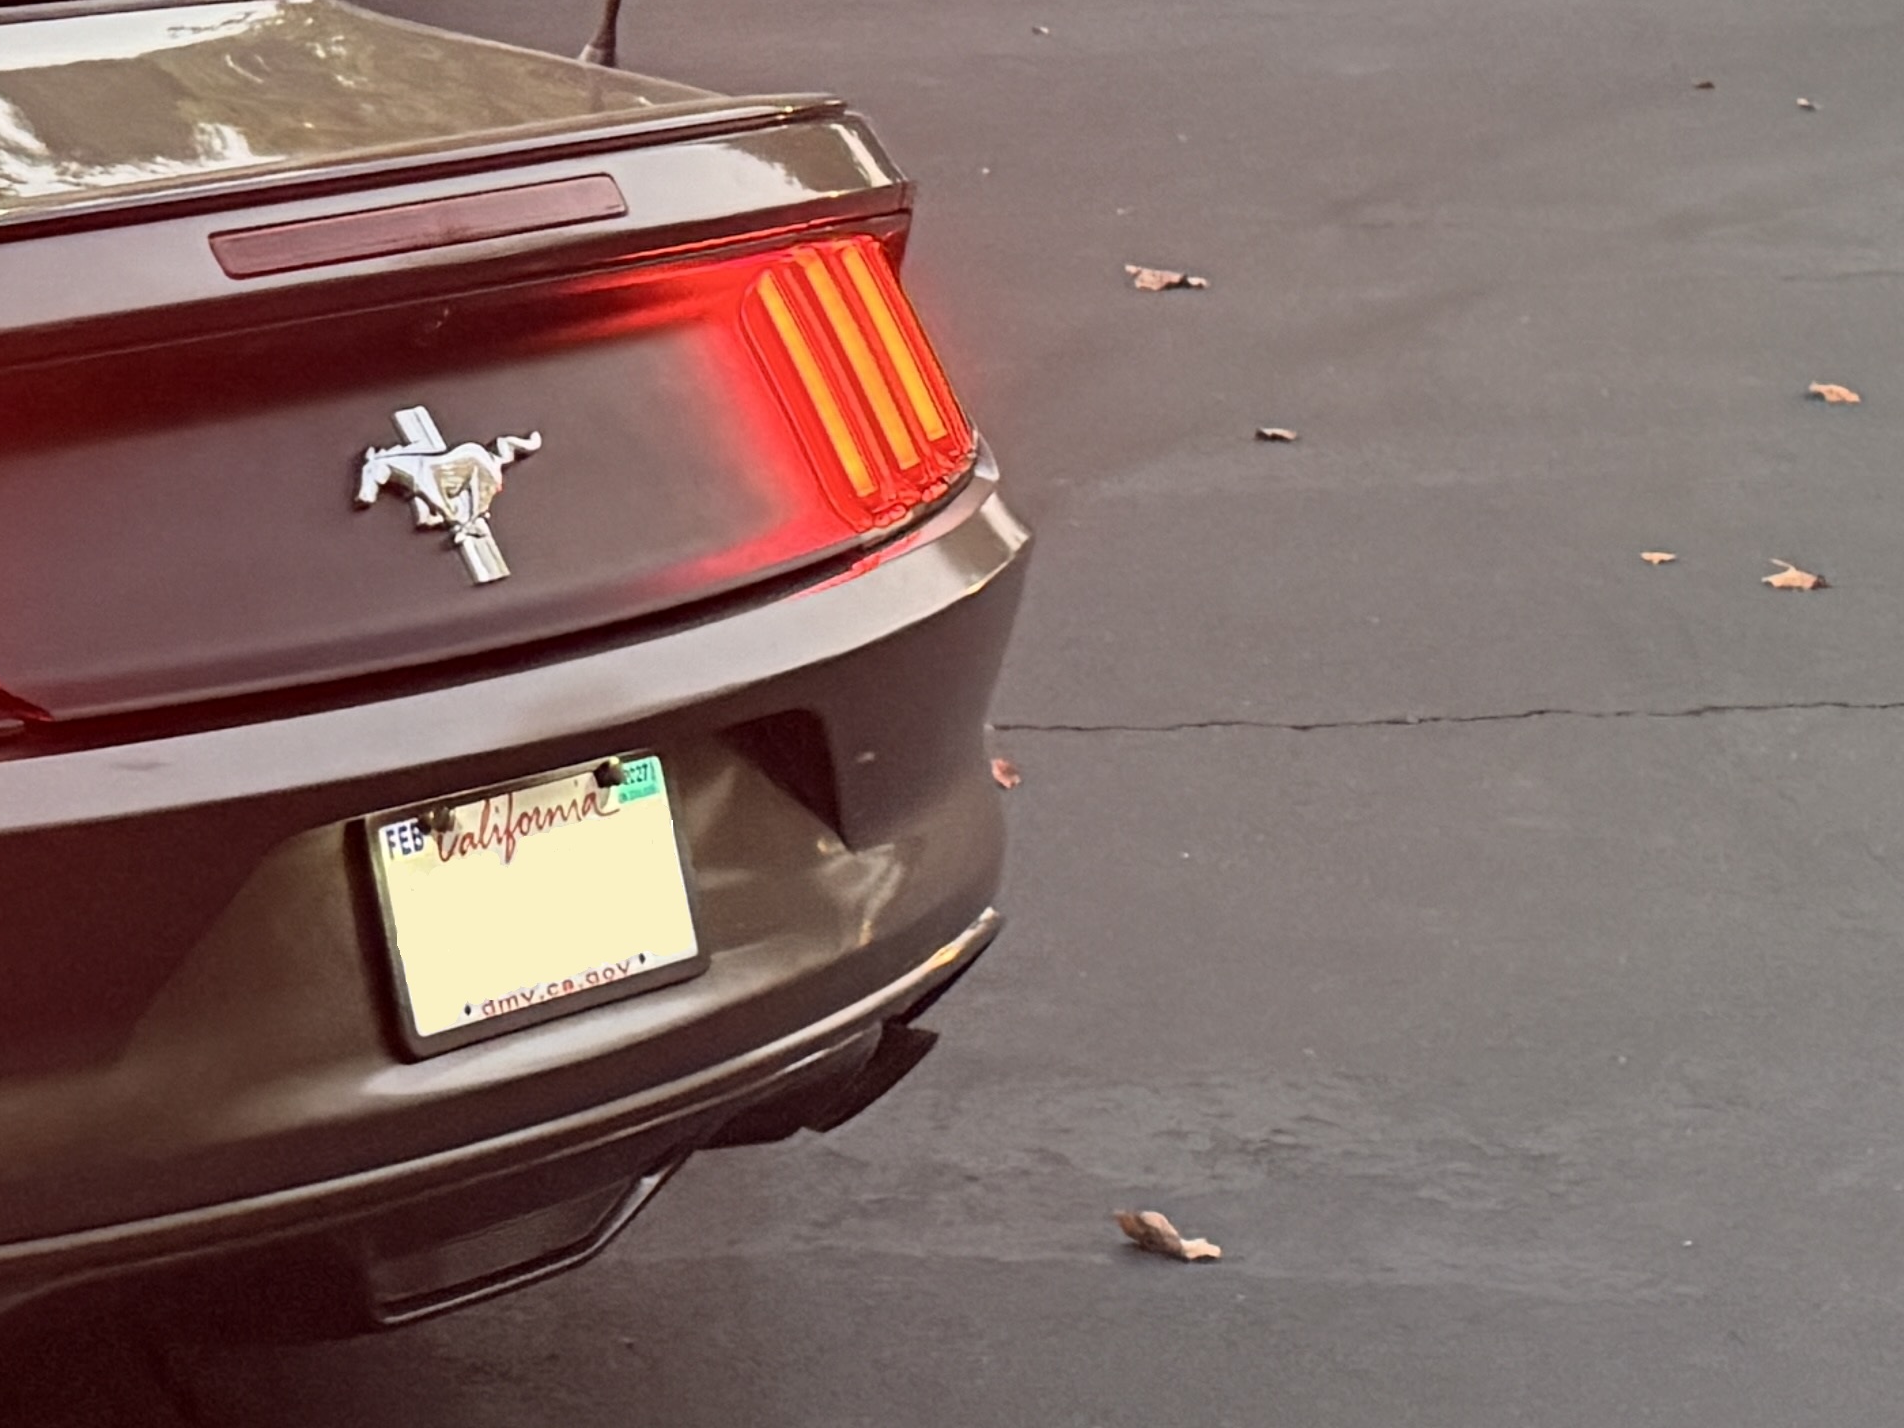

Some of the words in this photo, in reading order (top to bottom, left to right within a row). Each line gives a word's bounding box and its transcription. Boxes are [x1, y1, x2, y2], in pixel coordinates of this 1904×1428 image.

[385, 822, 424, 860] FEB
[437, 781, 621, 864] California
[481, 959, 630, 1016] dmv.ca.gov
